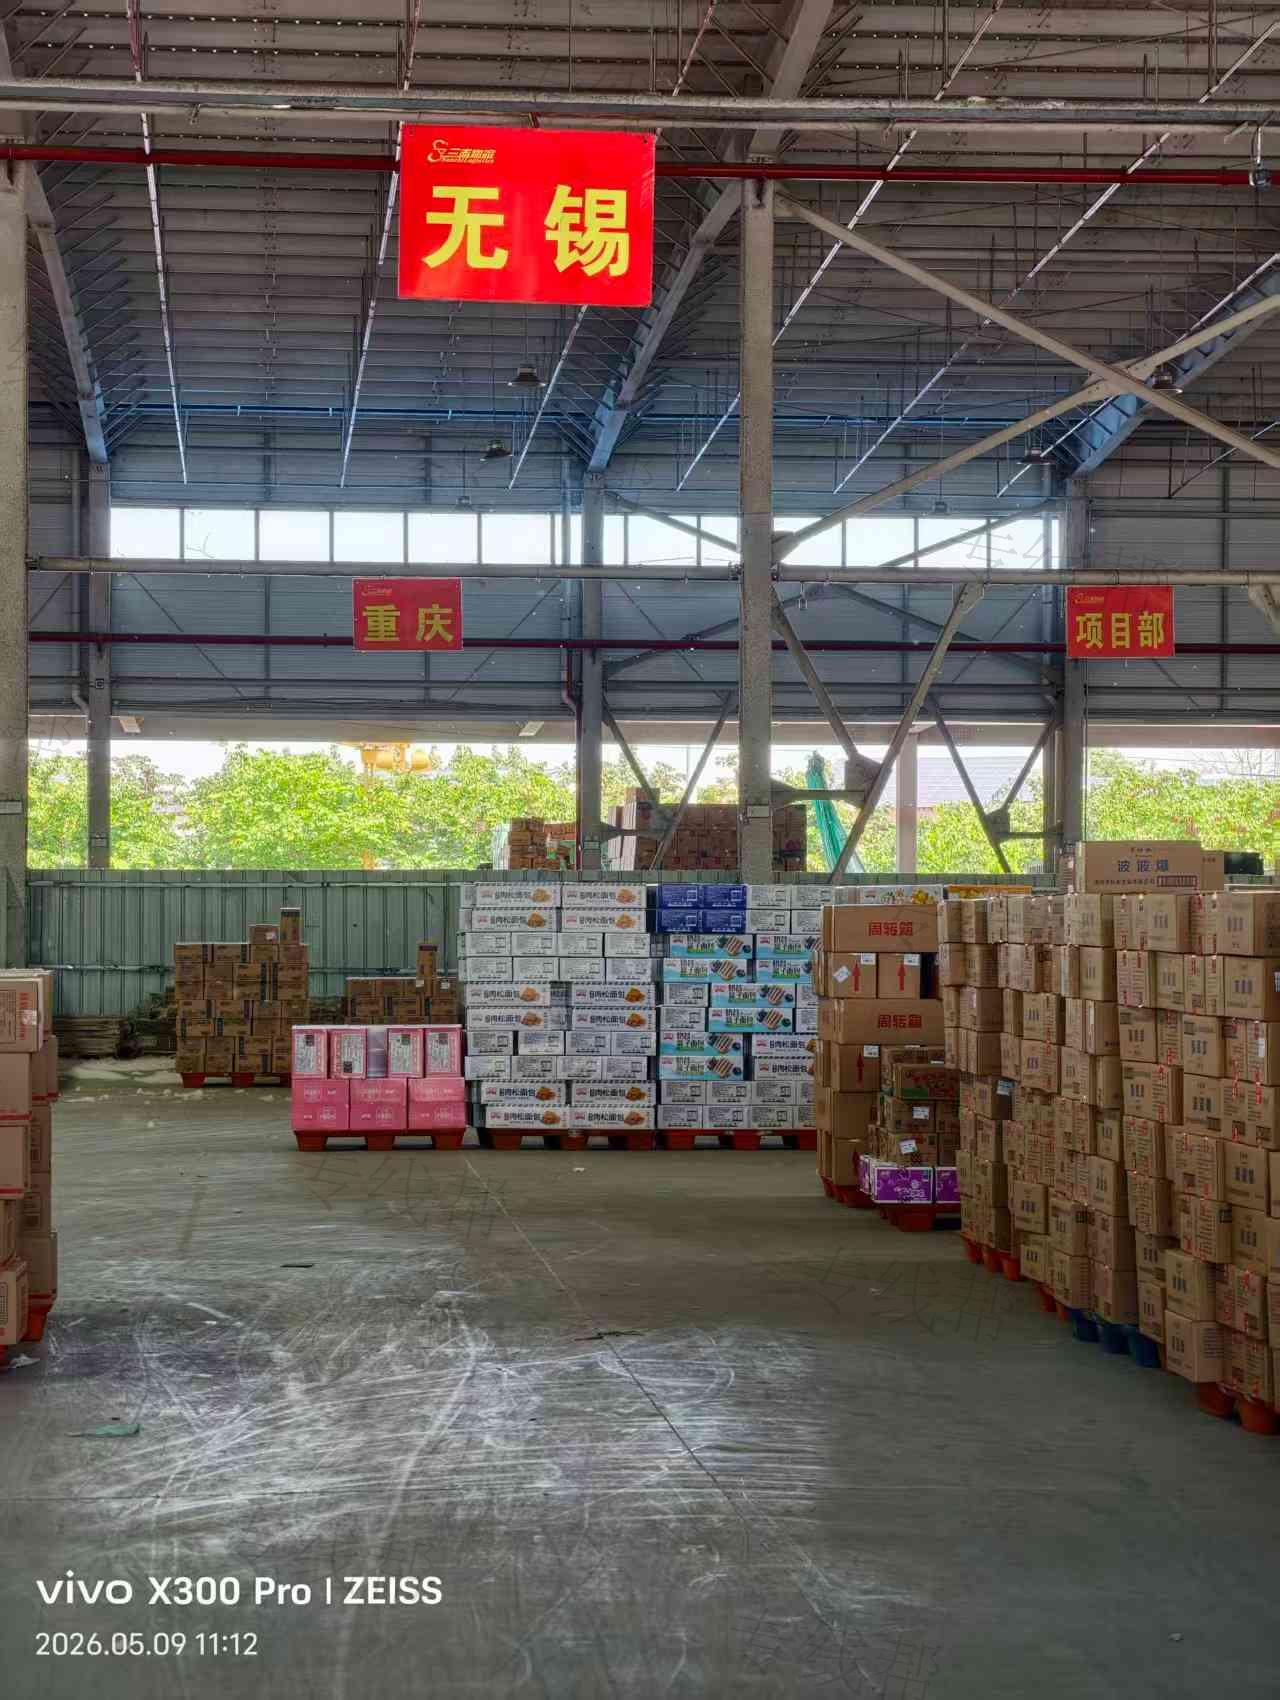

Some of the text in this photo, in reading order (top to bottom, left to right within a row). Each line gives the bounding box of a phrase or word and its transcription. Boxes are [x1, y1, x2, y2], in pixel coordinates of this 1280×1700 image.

[421, 184, 630, 277] 无锡
[362, 603, 454, 641] 重庆
[1076, 611, 1165, 649] 项目部
